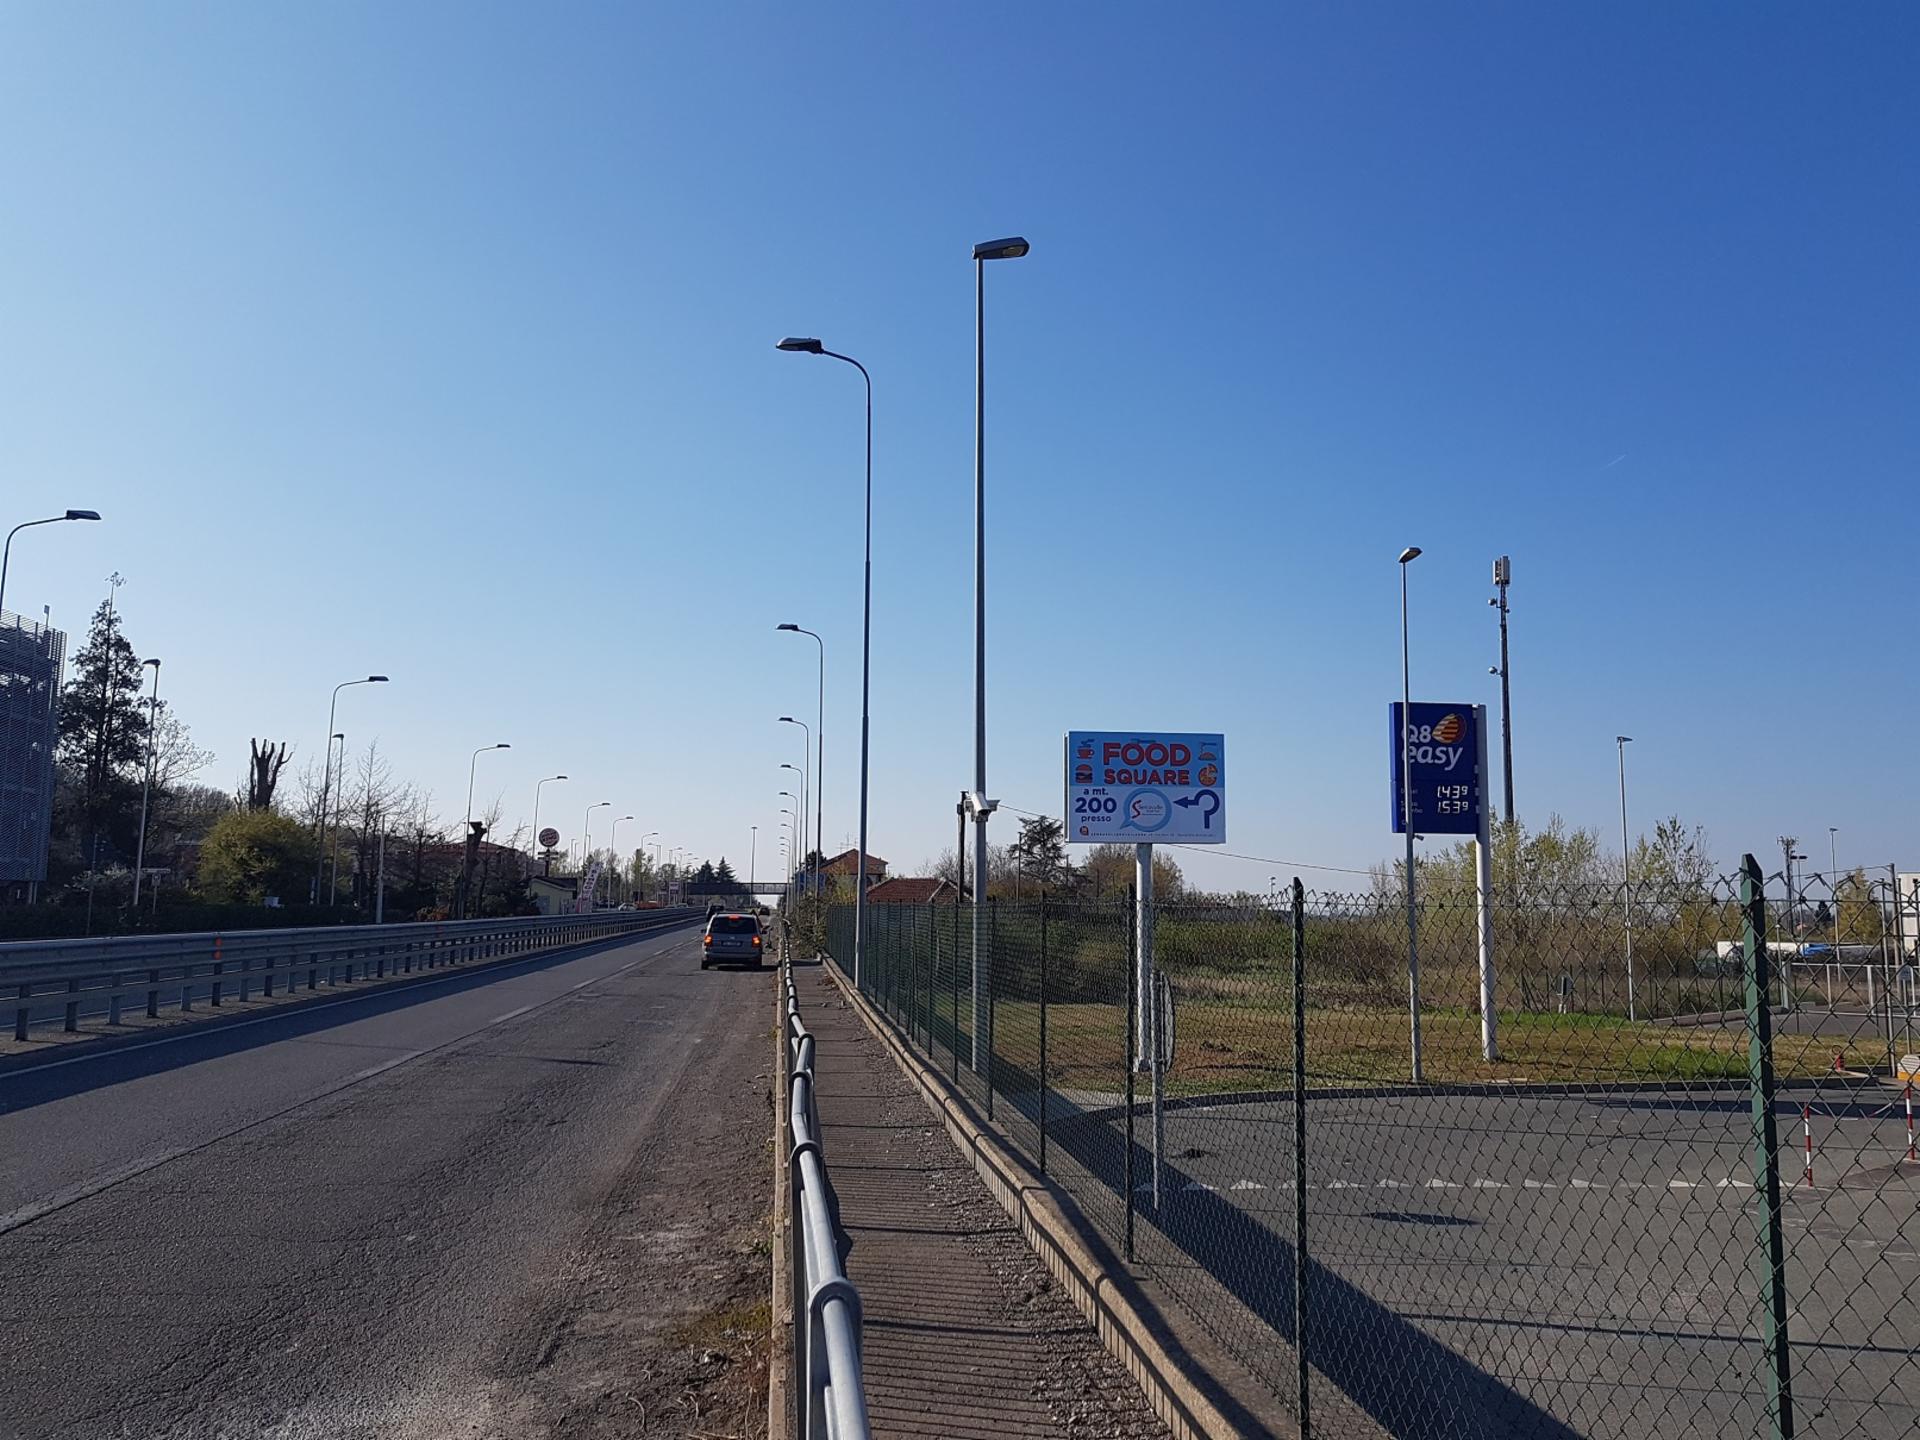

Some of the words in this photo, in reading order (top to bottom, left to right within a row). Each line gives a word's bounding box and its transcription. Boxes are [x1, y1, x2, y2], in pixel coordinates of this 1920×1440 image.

[1401, 724, 1432, 744] Q8
[1103, 742, 1191, 767] FOOD
[1401, 745, 1464, 771] easy
[1104, 768, 1190, 785] SQUARE
[1092, 787, 1109, 795] mt.
[1075, 797, 1117, 813] 200
[1081, 815, 1111, 823] presso
